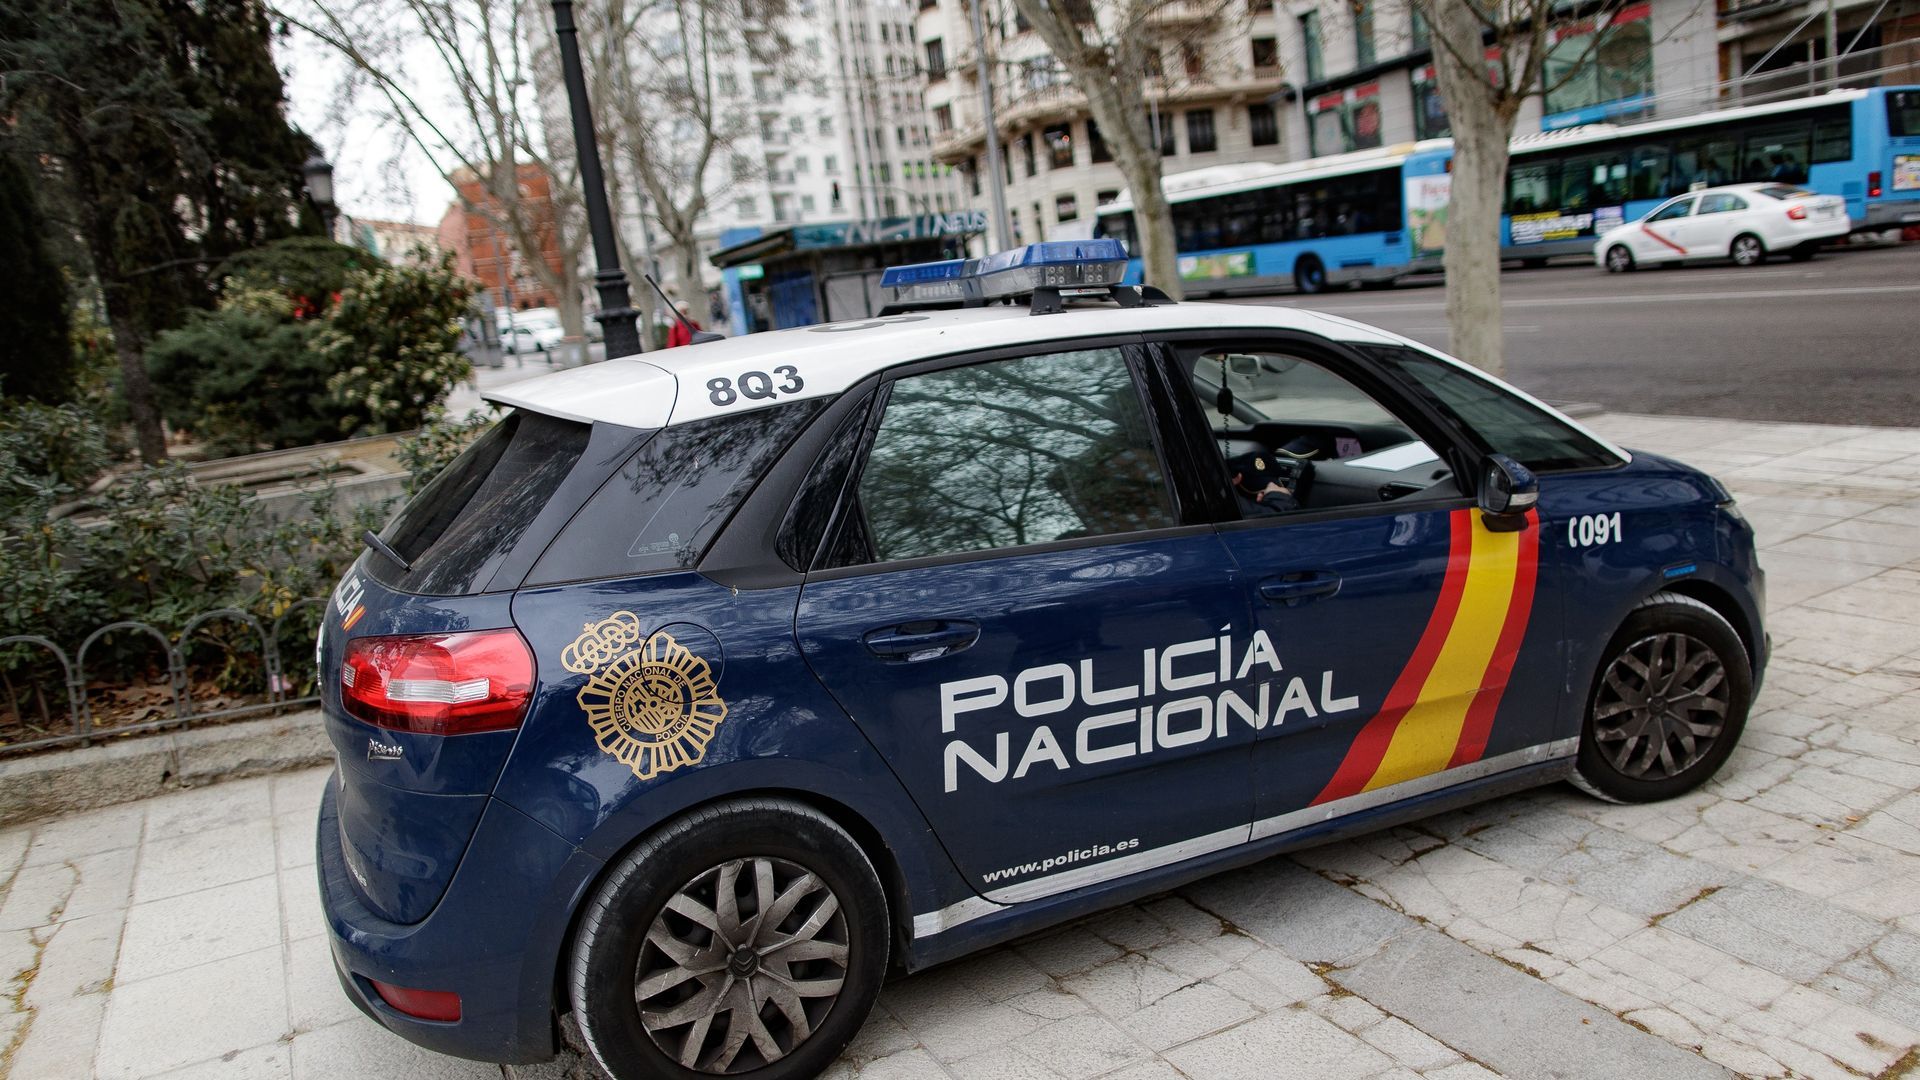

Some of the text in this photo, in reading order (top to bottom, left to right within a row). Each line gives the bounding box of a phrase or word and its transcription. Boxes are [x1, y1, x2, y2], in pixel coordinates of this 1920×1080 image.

[706, 365, 804, 406] 8Q3
[622, 666, 672, 689] NACIONAL
[674, 675, 688, 689] DE
[940, 623, 1283, 734] POLICÍA
[614, 689, 632, 732] CUERPO
[943, 670, 1359, 793] NACIONAL
[982, 837, 1140, 884] www.policia.es
